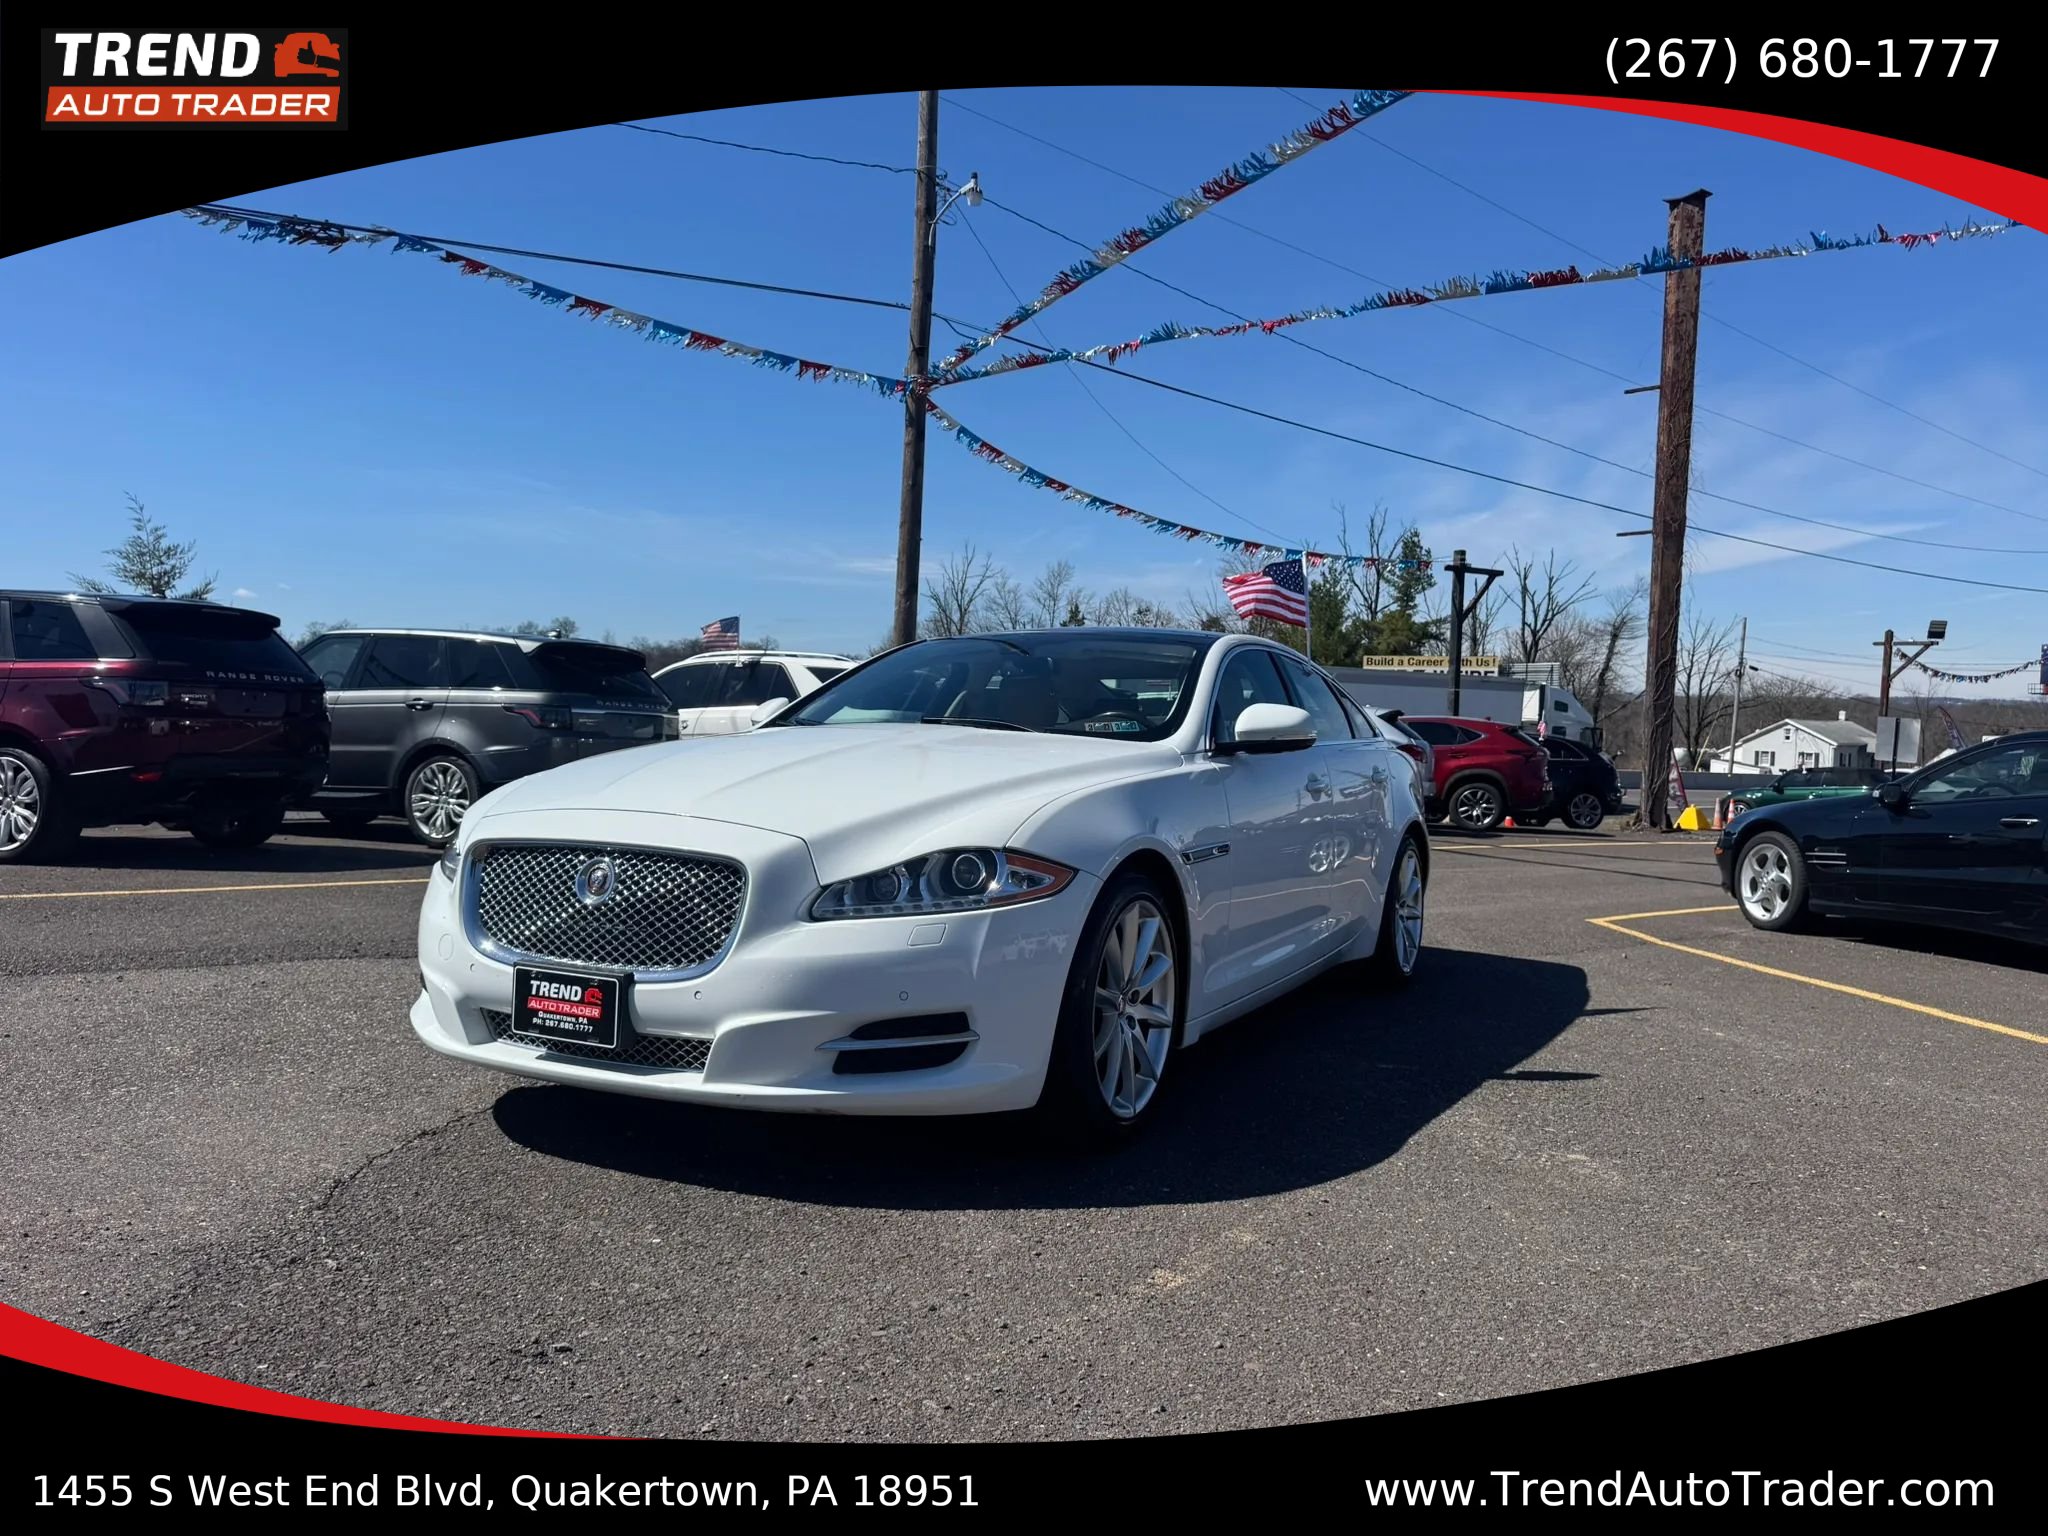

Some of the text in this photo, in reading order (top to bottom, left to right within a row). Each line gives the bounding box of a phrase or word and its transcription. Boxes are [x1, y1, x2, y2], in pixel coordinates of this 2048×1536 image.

[1366, 657, 1394, 667] Build
[1397, 658, 1404, 667] a
[1407, 657, 1445, 667] Career
[206, 671, 304, 683] RANGE ROVER
[530, 980, 582, 1002] TREND
[529, 999, 600, 1018] AUTO TRADER
[532, 1017, 593, 1033] PH: 267.680.1777
[578, 1016, 588, 1025] PA
